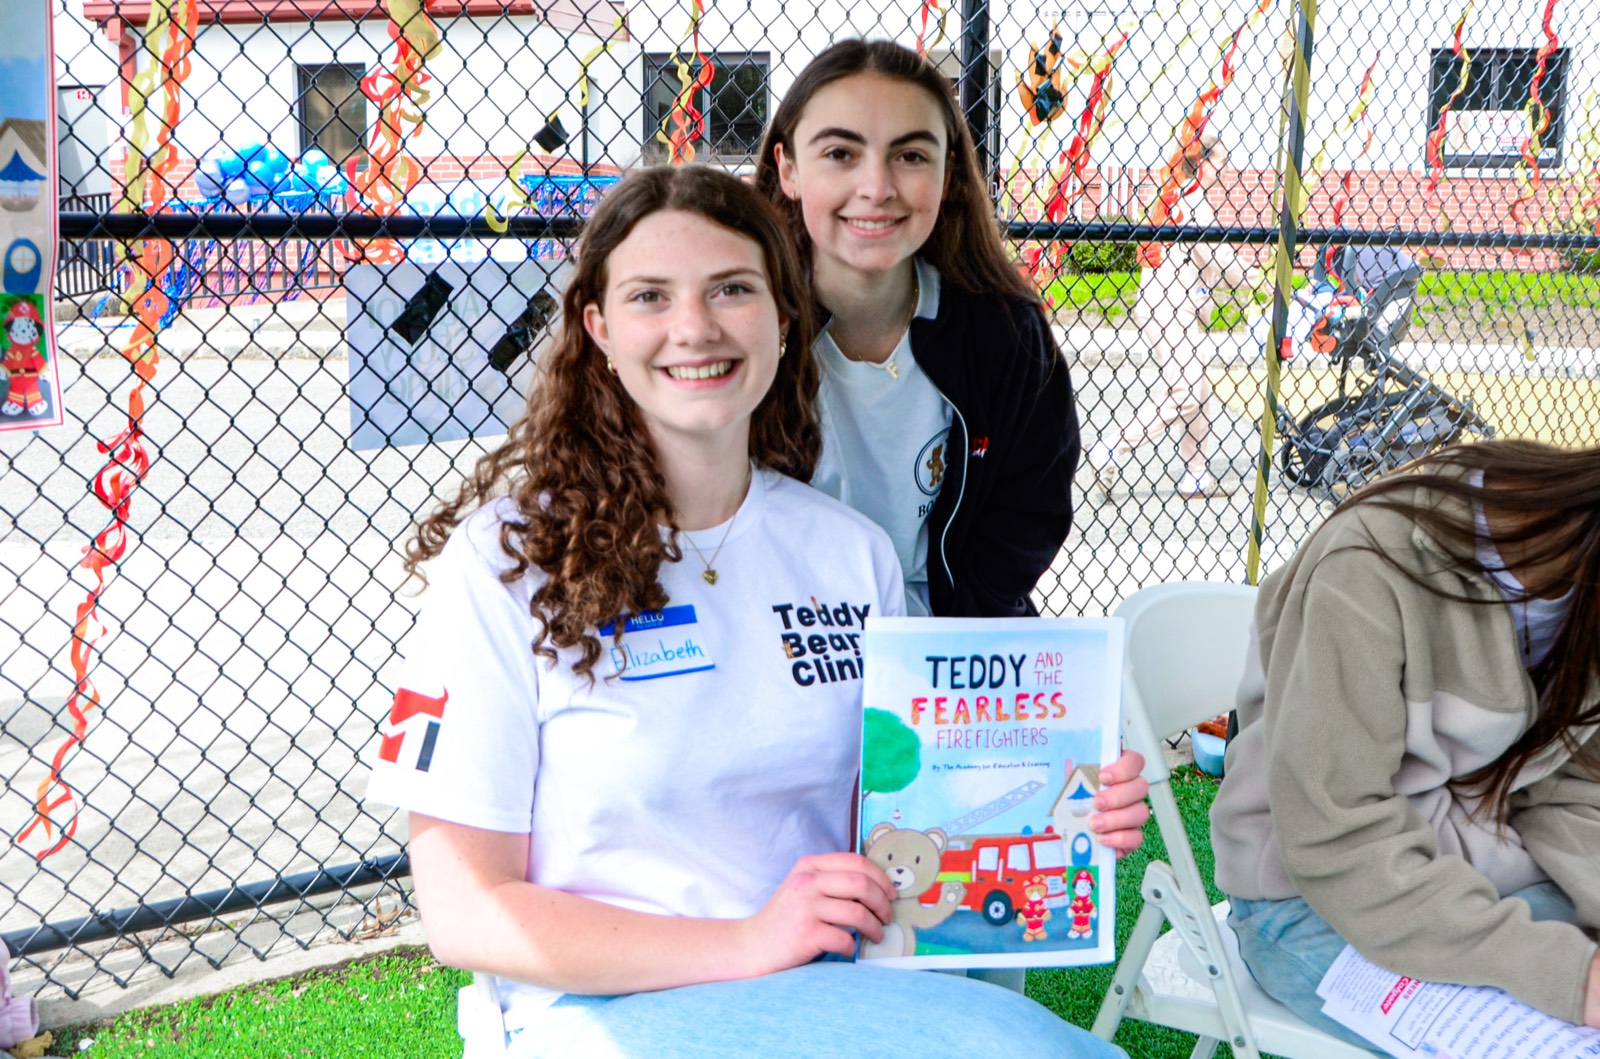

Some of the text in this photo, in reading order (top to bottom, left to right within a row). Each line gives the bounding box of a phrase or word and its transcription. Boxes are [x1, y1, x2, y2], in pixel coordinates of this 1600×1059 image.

[631, 613, 665, 625] HELLO
[772, 601, 871, 631] Teddy
[610, 638, 705, 672] Elizabeth
[781, 632, 860, 659] Bear
[792, 649, 864, 687] Clini
[925, 651, 1063, 690] TEDDY AND
[1034, 669, 1063, 686] THE
[911, 691, 1067, 726] FEARLESS
[936, 726, 1049, 750] FIREFIGHTERS
[1382, 977, 1409, 1010] Colgate
[1436, 1014, 1456, 1037] Police
[1447, 1022, 1469, 1048] course
